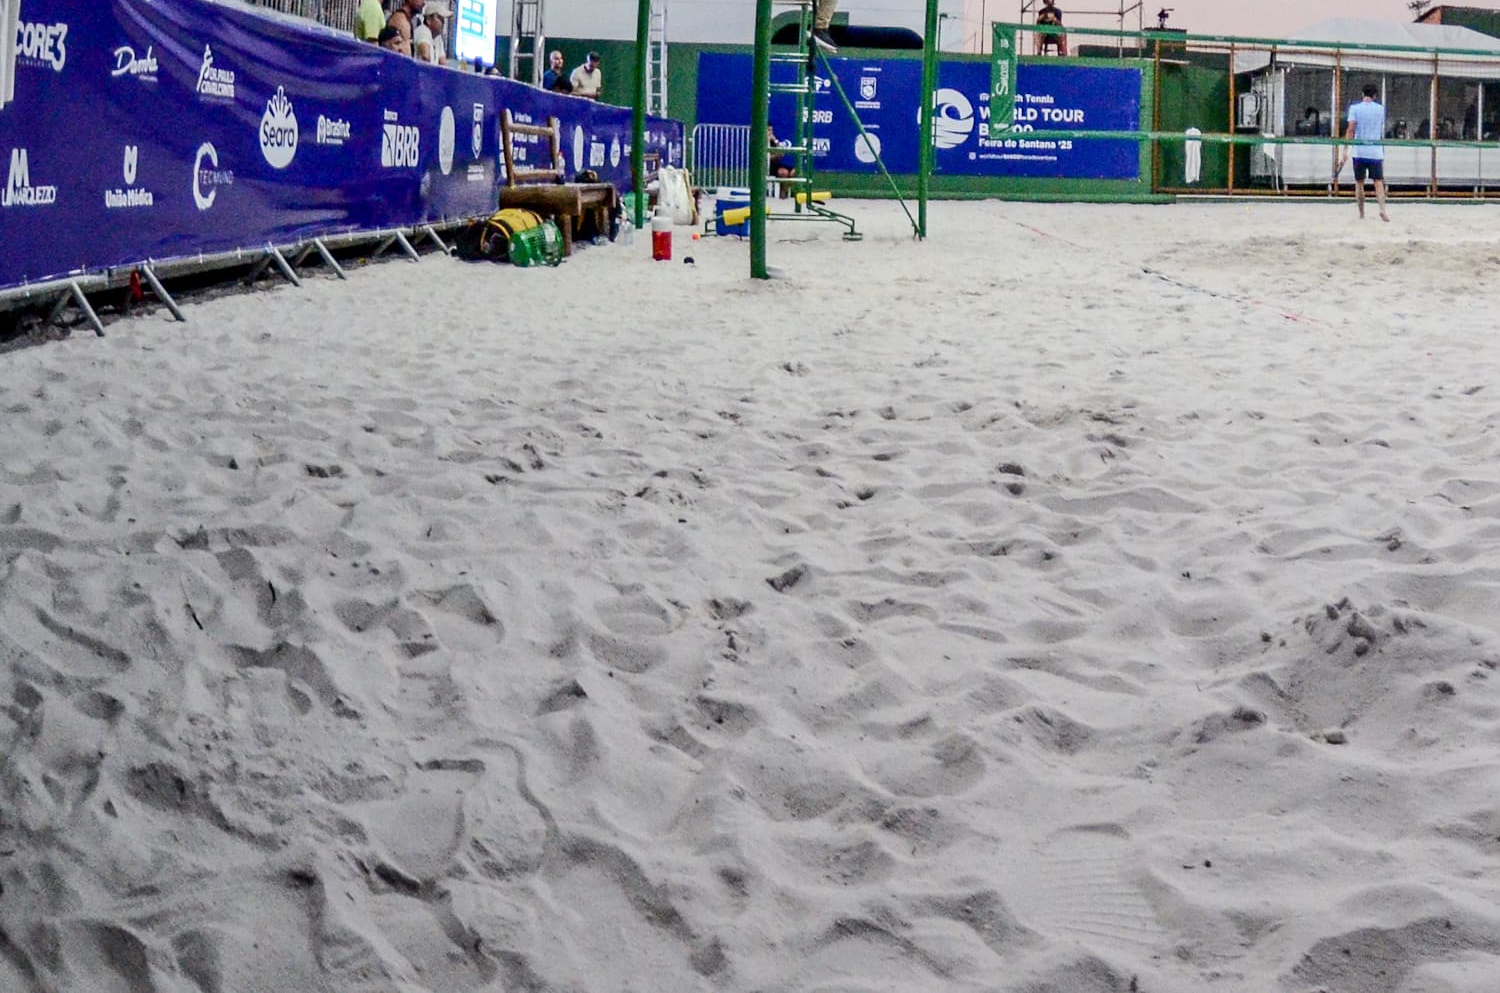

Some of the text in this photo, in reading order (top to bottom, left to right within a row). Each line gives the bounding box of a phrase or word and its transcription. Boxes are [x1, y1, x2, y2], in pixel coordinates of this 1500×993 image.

[15, 20, 68, 71] CORE3
[1025, 94, 1054, 104] Tennis
[1041, 108, 1085, 123] TOUR
[263, 120, 295, 148] Seara
[979, 138, 1003, 148] Feira
[1004, 140, 1018, 149] de
[1019, 140, 1057, 150] Santana
[395, 125, 420, 167] BRB
